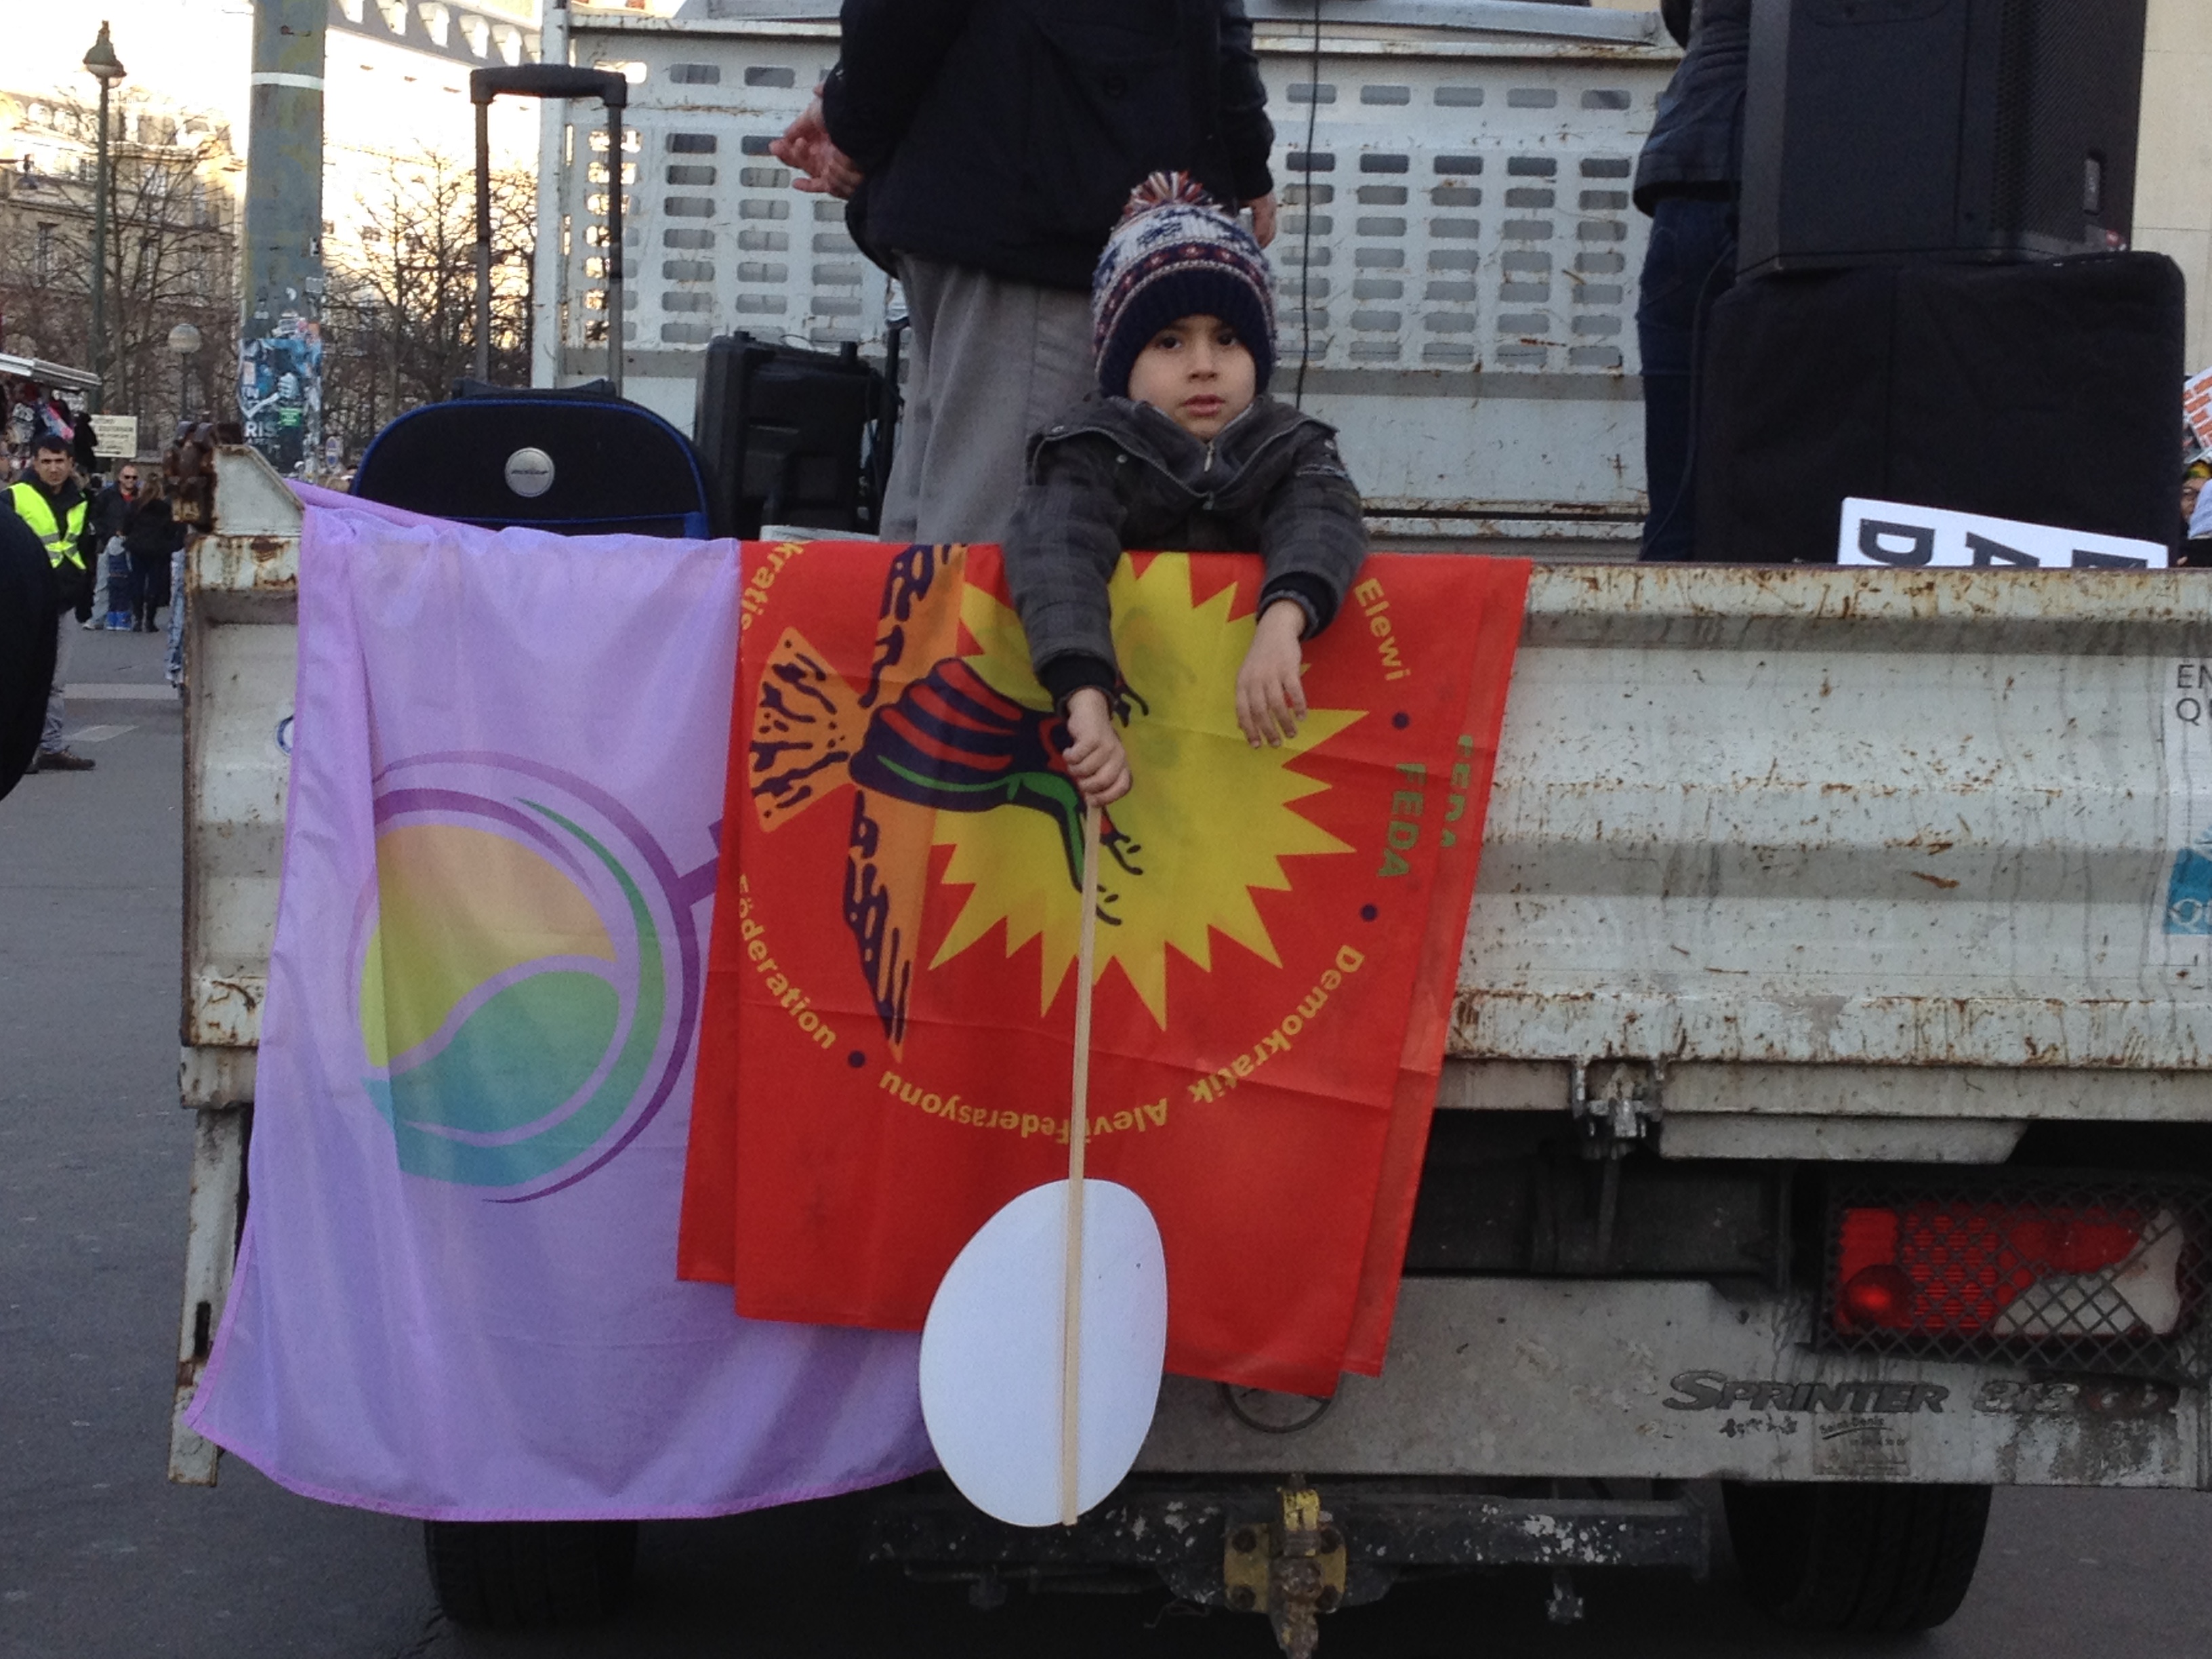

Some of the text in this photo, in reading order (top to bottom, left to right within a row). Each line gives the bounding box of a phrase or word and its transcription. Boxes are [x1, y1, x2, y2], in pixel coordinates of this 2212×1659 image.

[1354, 578, 1410, 680] Elewi
[2176, 697, 2212, 726] Q
[1378, 763, 1427, 877] FEDA
[2170, 898, 2212, 933] Q
[1187, 945, 1365, 1103] Demokratik
[880, 1071, 1071, 1145] Federasyonu
[1662, 1370, 1950, 1413] SPRINTER
